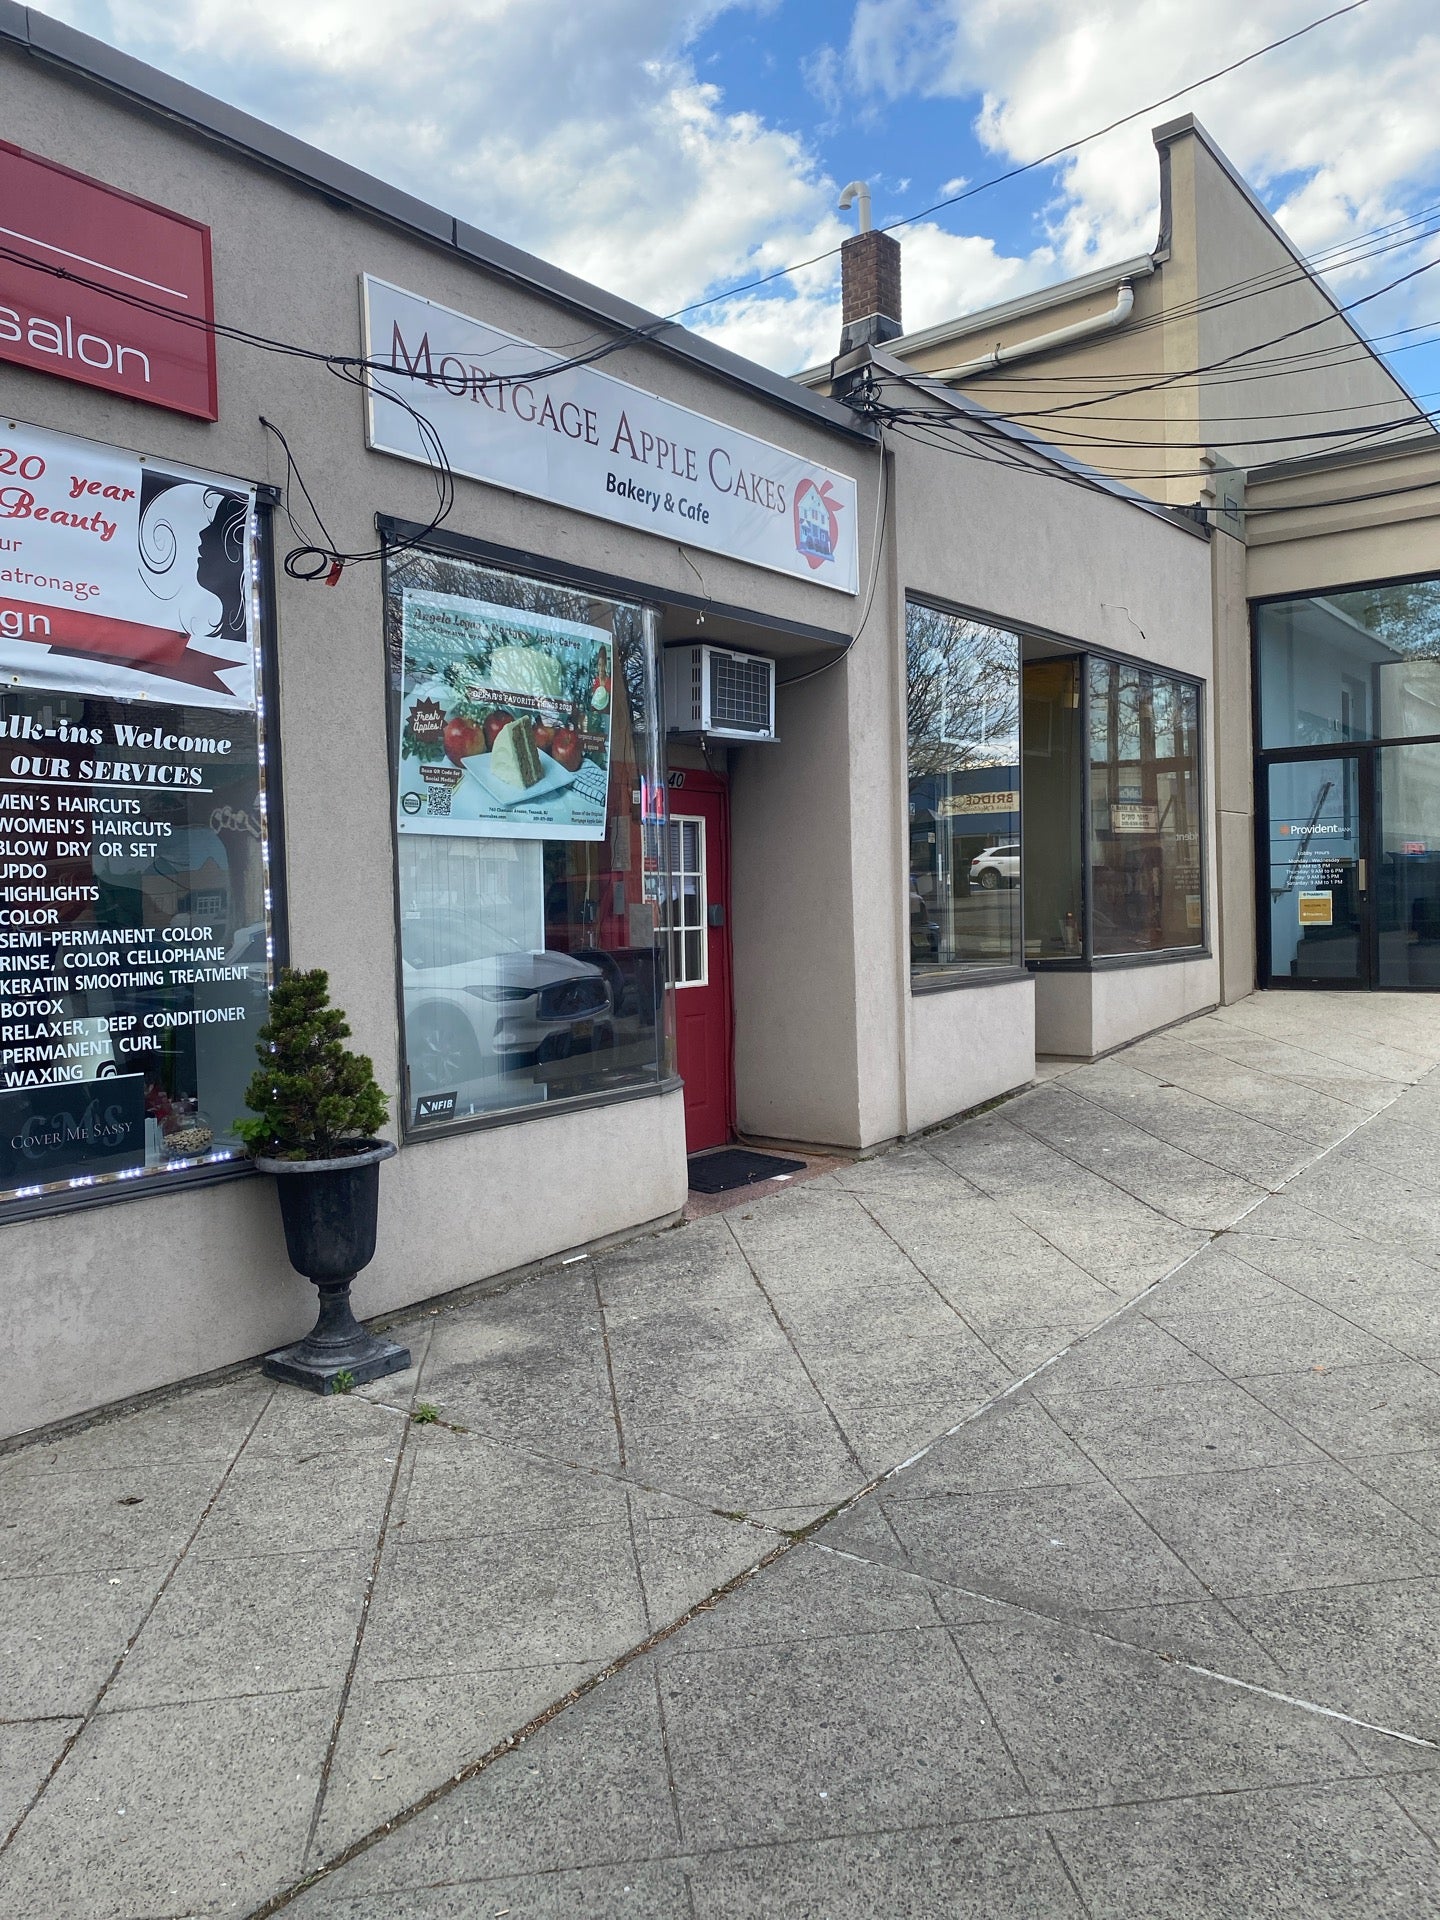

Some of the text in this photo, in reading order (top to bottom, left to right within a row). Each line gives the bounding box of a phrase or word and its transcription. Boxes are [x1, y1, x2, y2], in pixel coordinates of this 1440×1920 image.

[0, 305, 150, 383] salon
[391, 319, 786, 514] MORTGAGE APPLE CAKES
[0, 448, 136, 502] 20 year
[606, 472, 710, 524] Bakery & Cafe
[0, 486, 118, 542] Beauty
[504, 693, 536, 707] FAVORITE
[413, 710, 441, 722] Fresh
[413, 720, 444, 734] Apples!
[113, 723, 232, 755] Welcome
[10, 755, 203, 786] OUR SERVICES
[57, 798, 141, 814] HAIRCUTS
[0, 817, 172, 837] WOMEN'S HAIRCUTS
[1290, 824, 1339, 835] Provident
[56, 842, 92, 857] DRY
[99, 842, 124, 857] OR
[130, 843, 157, 858] SET
[0, 886, 100, 902] HIGHLIGHTS
[0, 909, 59, 926] COLOR
[0, 926, 213, 949] SEMI-PERMANENT COLOR
[0, 947, 225, 972] RINSE, COLOR CELLOPHANE
[0, 966, 249, 995] KERATIN SMOOTHING TREATMENT
[1, 999, 64, 1018] BOTOX
[2, 1007, 246, 1042] RELAXER, DEEP CONDITIONER
[3, 1034, 162, 1064] PERMANENT CURL
[4, 1065, 83, 1087] WAXING
[431, 1099, 454, 1111] NFIB
